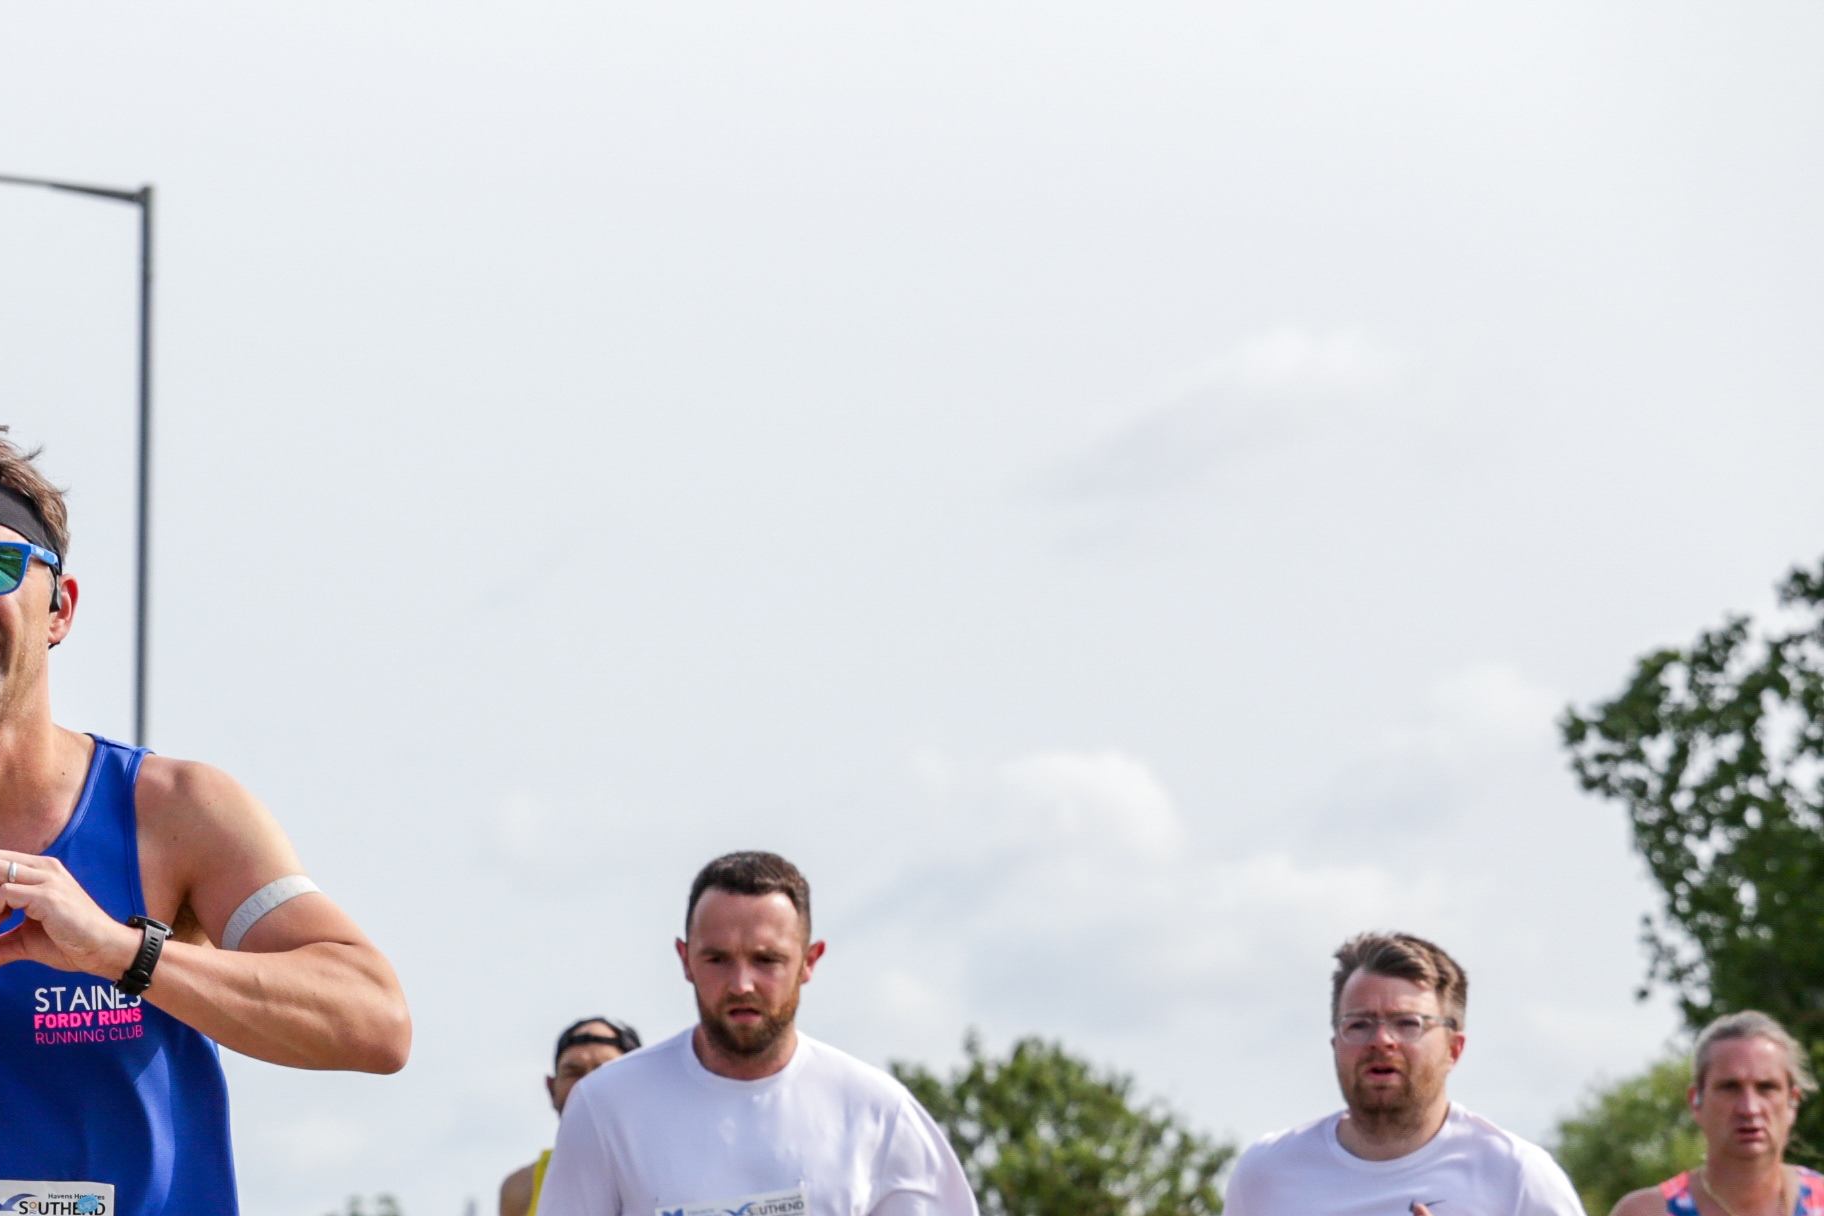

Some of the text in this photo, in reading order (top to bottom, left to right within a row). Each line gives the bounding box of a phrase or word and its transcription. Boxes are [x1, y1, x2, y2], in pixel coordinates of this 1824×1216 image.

[34, 1008, 142, 1029] FORDY RUNS
[35, 1025, 143, 1045] RUNNING CLUB
[747, 1201, 804, 1216] SOUTHEND
